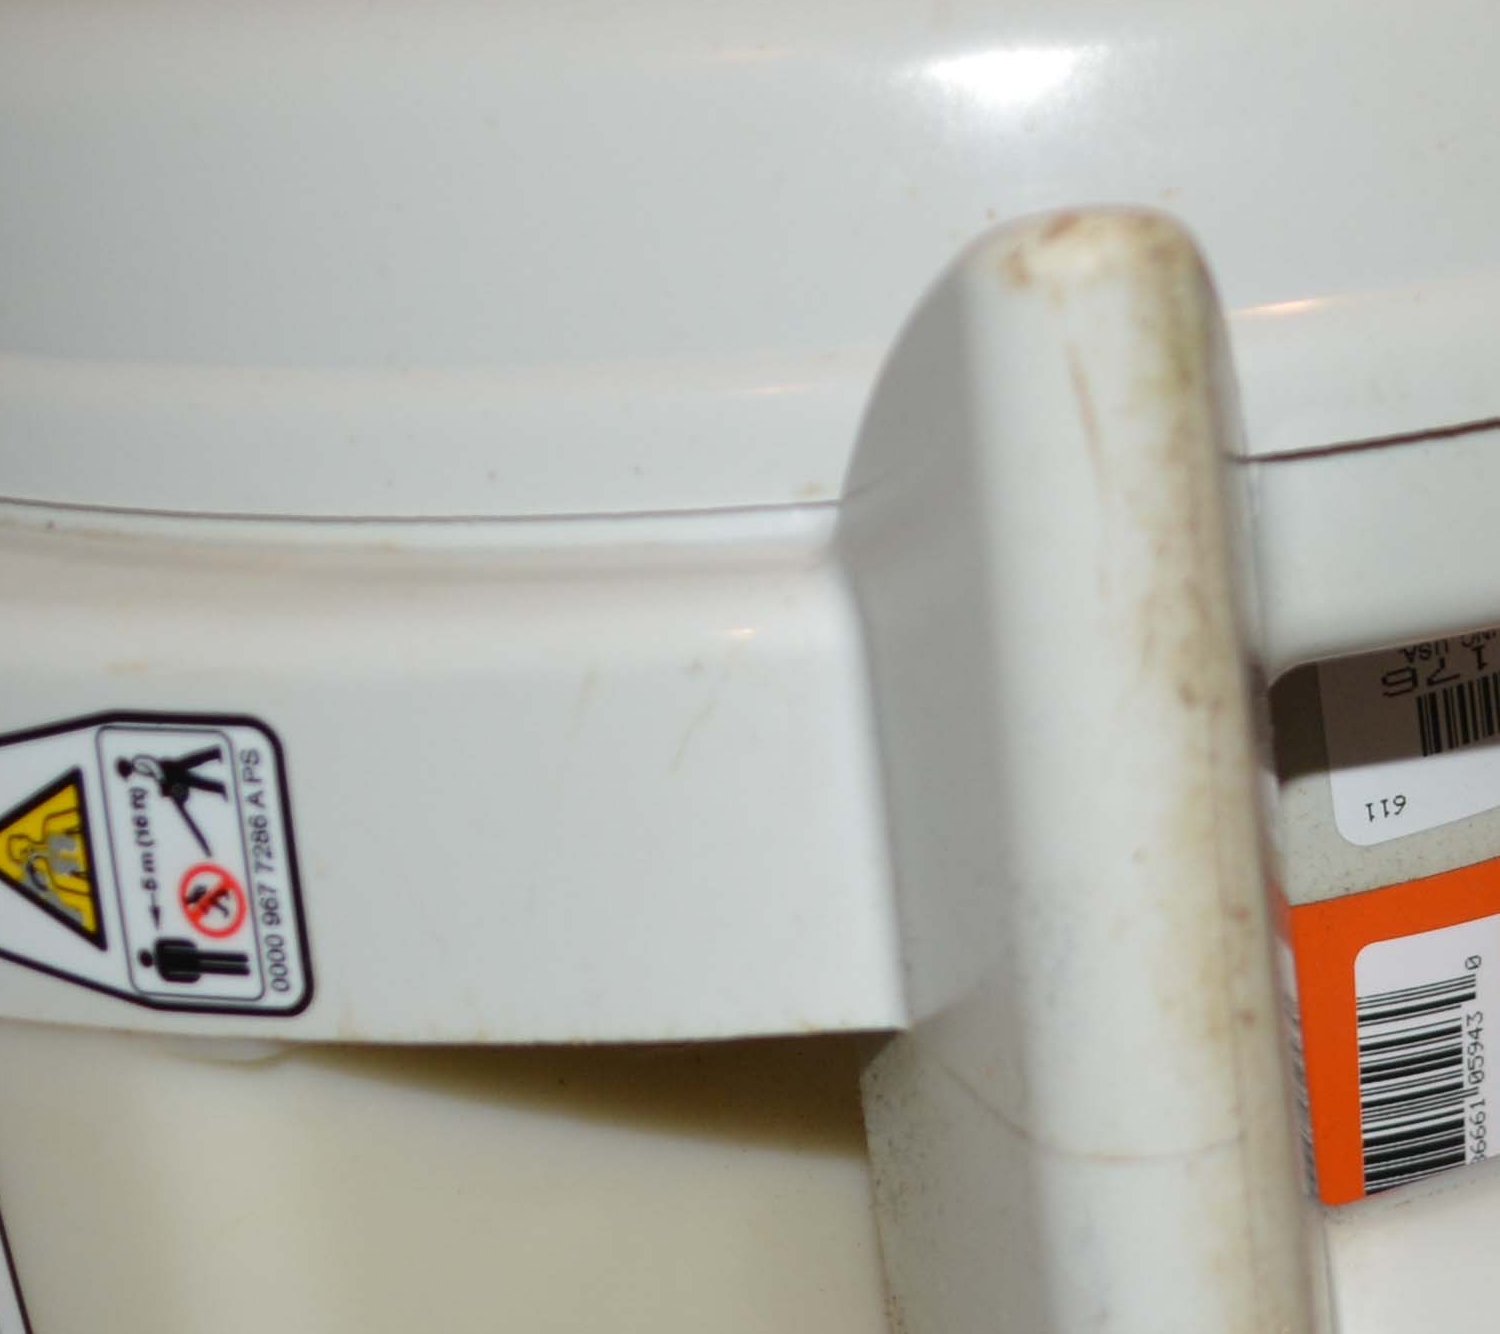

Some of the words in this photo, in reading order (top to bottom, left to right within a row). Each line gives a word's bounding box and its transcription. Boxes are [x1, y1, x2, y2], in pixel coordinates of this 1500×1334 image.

[237, 748, 262, 783] PS
[243, 790, 265, 807] A
[1365, 795, 1406, 823] 611
[247, 814, 274, 872] 7286
[257, 882, 281, 925] 967
[263, 934, 291, 991] 0000
[1464, 955, 1482, 970] 0
[1466, 1011, 1485, 1085] 05943
